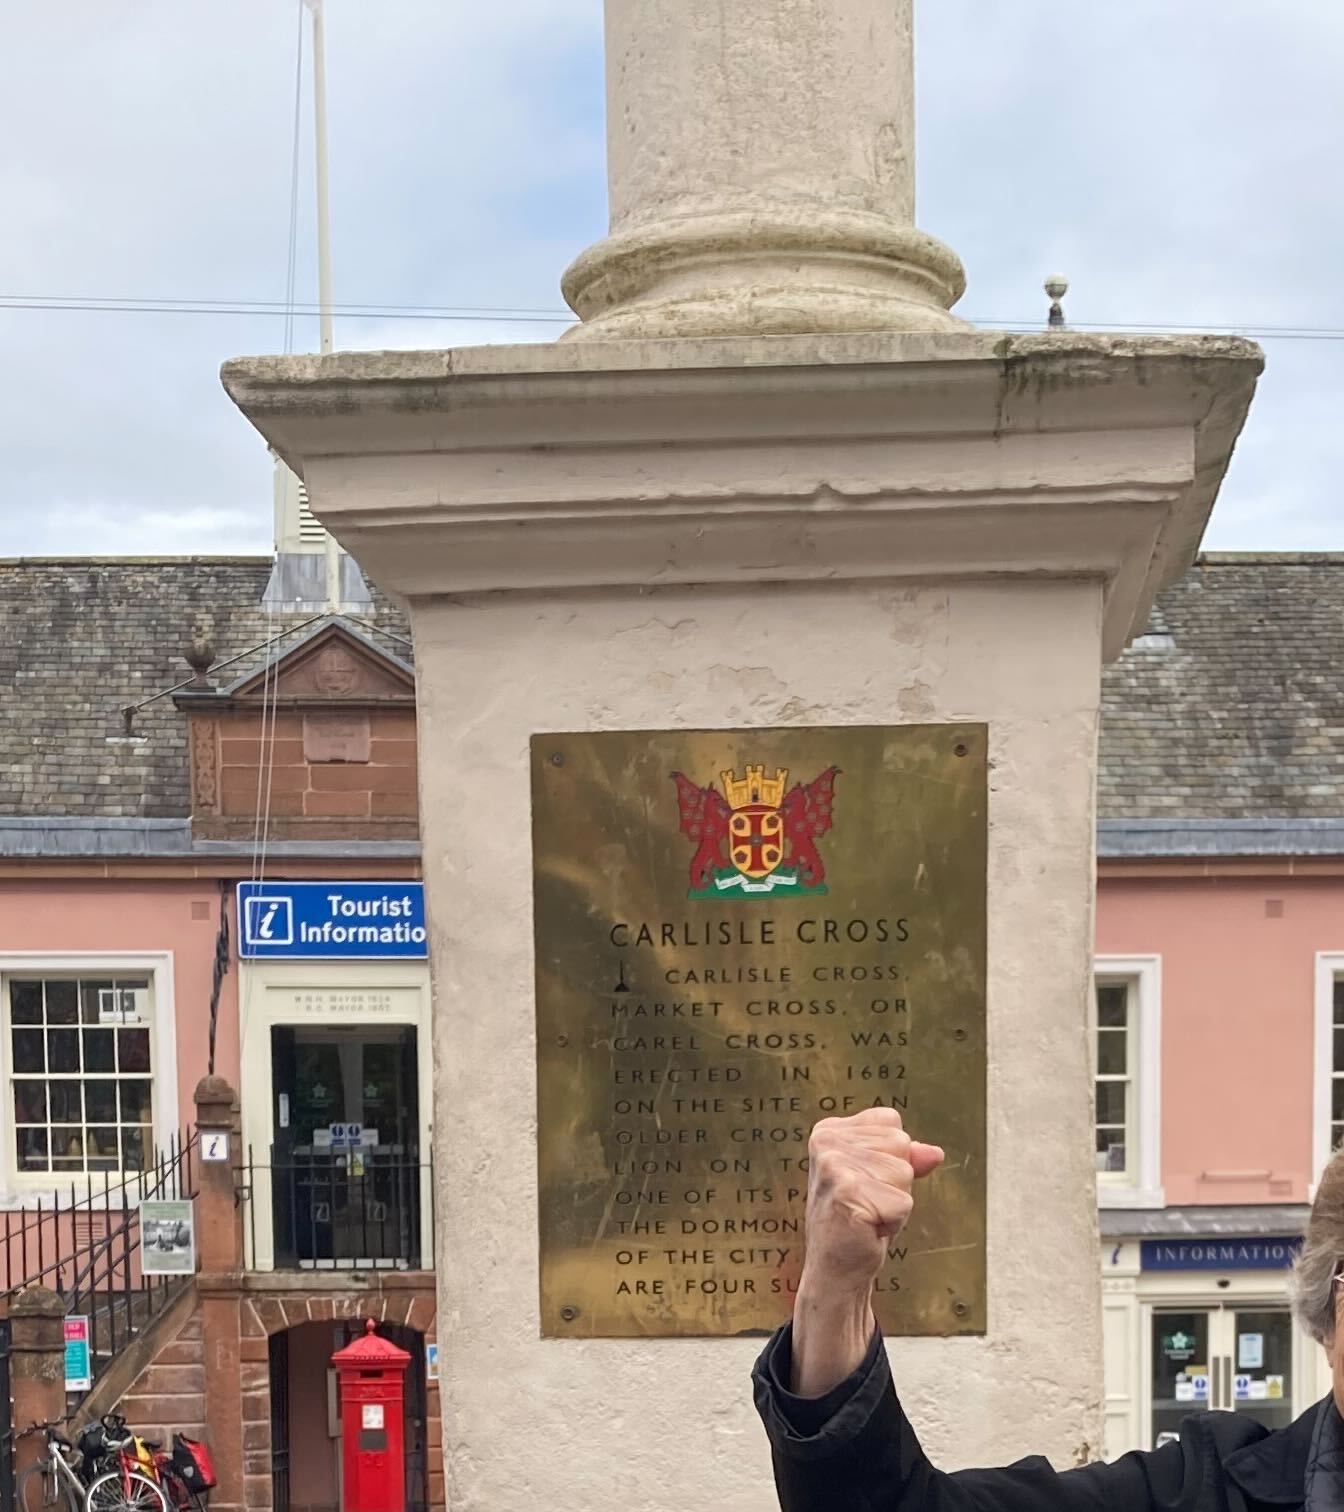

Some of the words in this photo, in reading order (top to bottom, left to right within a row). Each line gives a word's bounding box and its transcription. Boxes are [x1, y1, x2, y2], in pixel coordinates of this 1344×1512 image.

[327, 895, 412, 917] Tourist
[300, 922, 426, 943] Informatio
[610, 921, 775, 947] CARLISLE
[797, 919, 910, 943] CROSS
[665, 967, 792, 985] CARLISLE
[612, 1002, 724, 1017] MARKET
[871, 1000, 907, 1013] OR
[613, 1035, 701, 1050] CAREL
[851, 1032, 908, 1047] WAS
[615, 1068, 742, 1084] ERECTED
[782, 1067, 810, 1081] IN
[847, 1065, 906, 1080] 1682
[614, 1101, 654, 1115] ON
[676, 1100, 725, 1113] THE
[743, 1098, 801, 1112] SITE
[819, 1096, 855, 1110] OF
[616, 1129, 707, 1145] OLDER
[731, 1127, 810, 1143] CROS
[614, 1160, 681, 1175] LION
[710, 1159, 750, 1173] ON
[616, 1190, 672, 1205] ONE
[684, 1189, 717, 1203] OF
[737, 1189, 773, 1202] ITS
[618, 1220, 666, 1235] THE
[682, 1219, 799, 1233] DORMON
[616, 1251, 650, 1265] OF
[663, 1250, 715, 1264] THE
[1156, 1244, 1299, 1261] INFORMATION
[616, 1280, 664, 1295] ARE
[686, 1280, 755, 1294] FOUR
